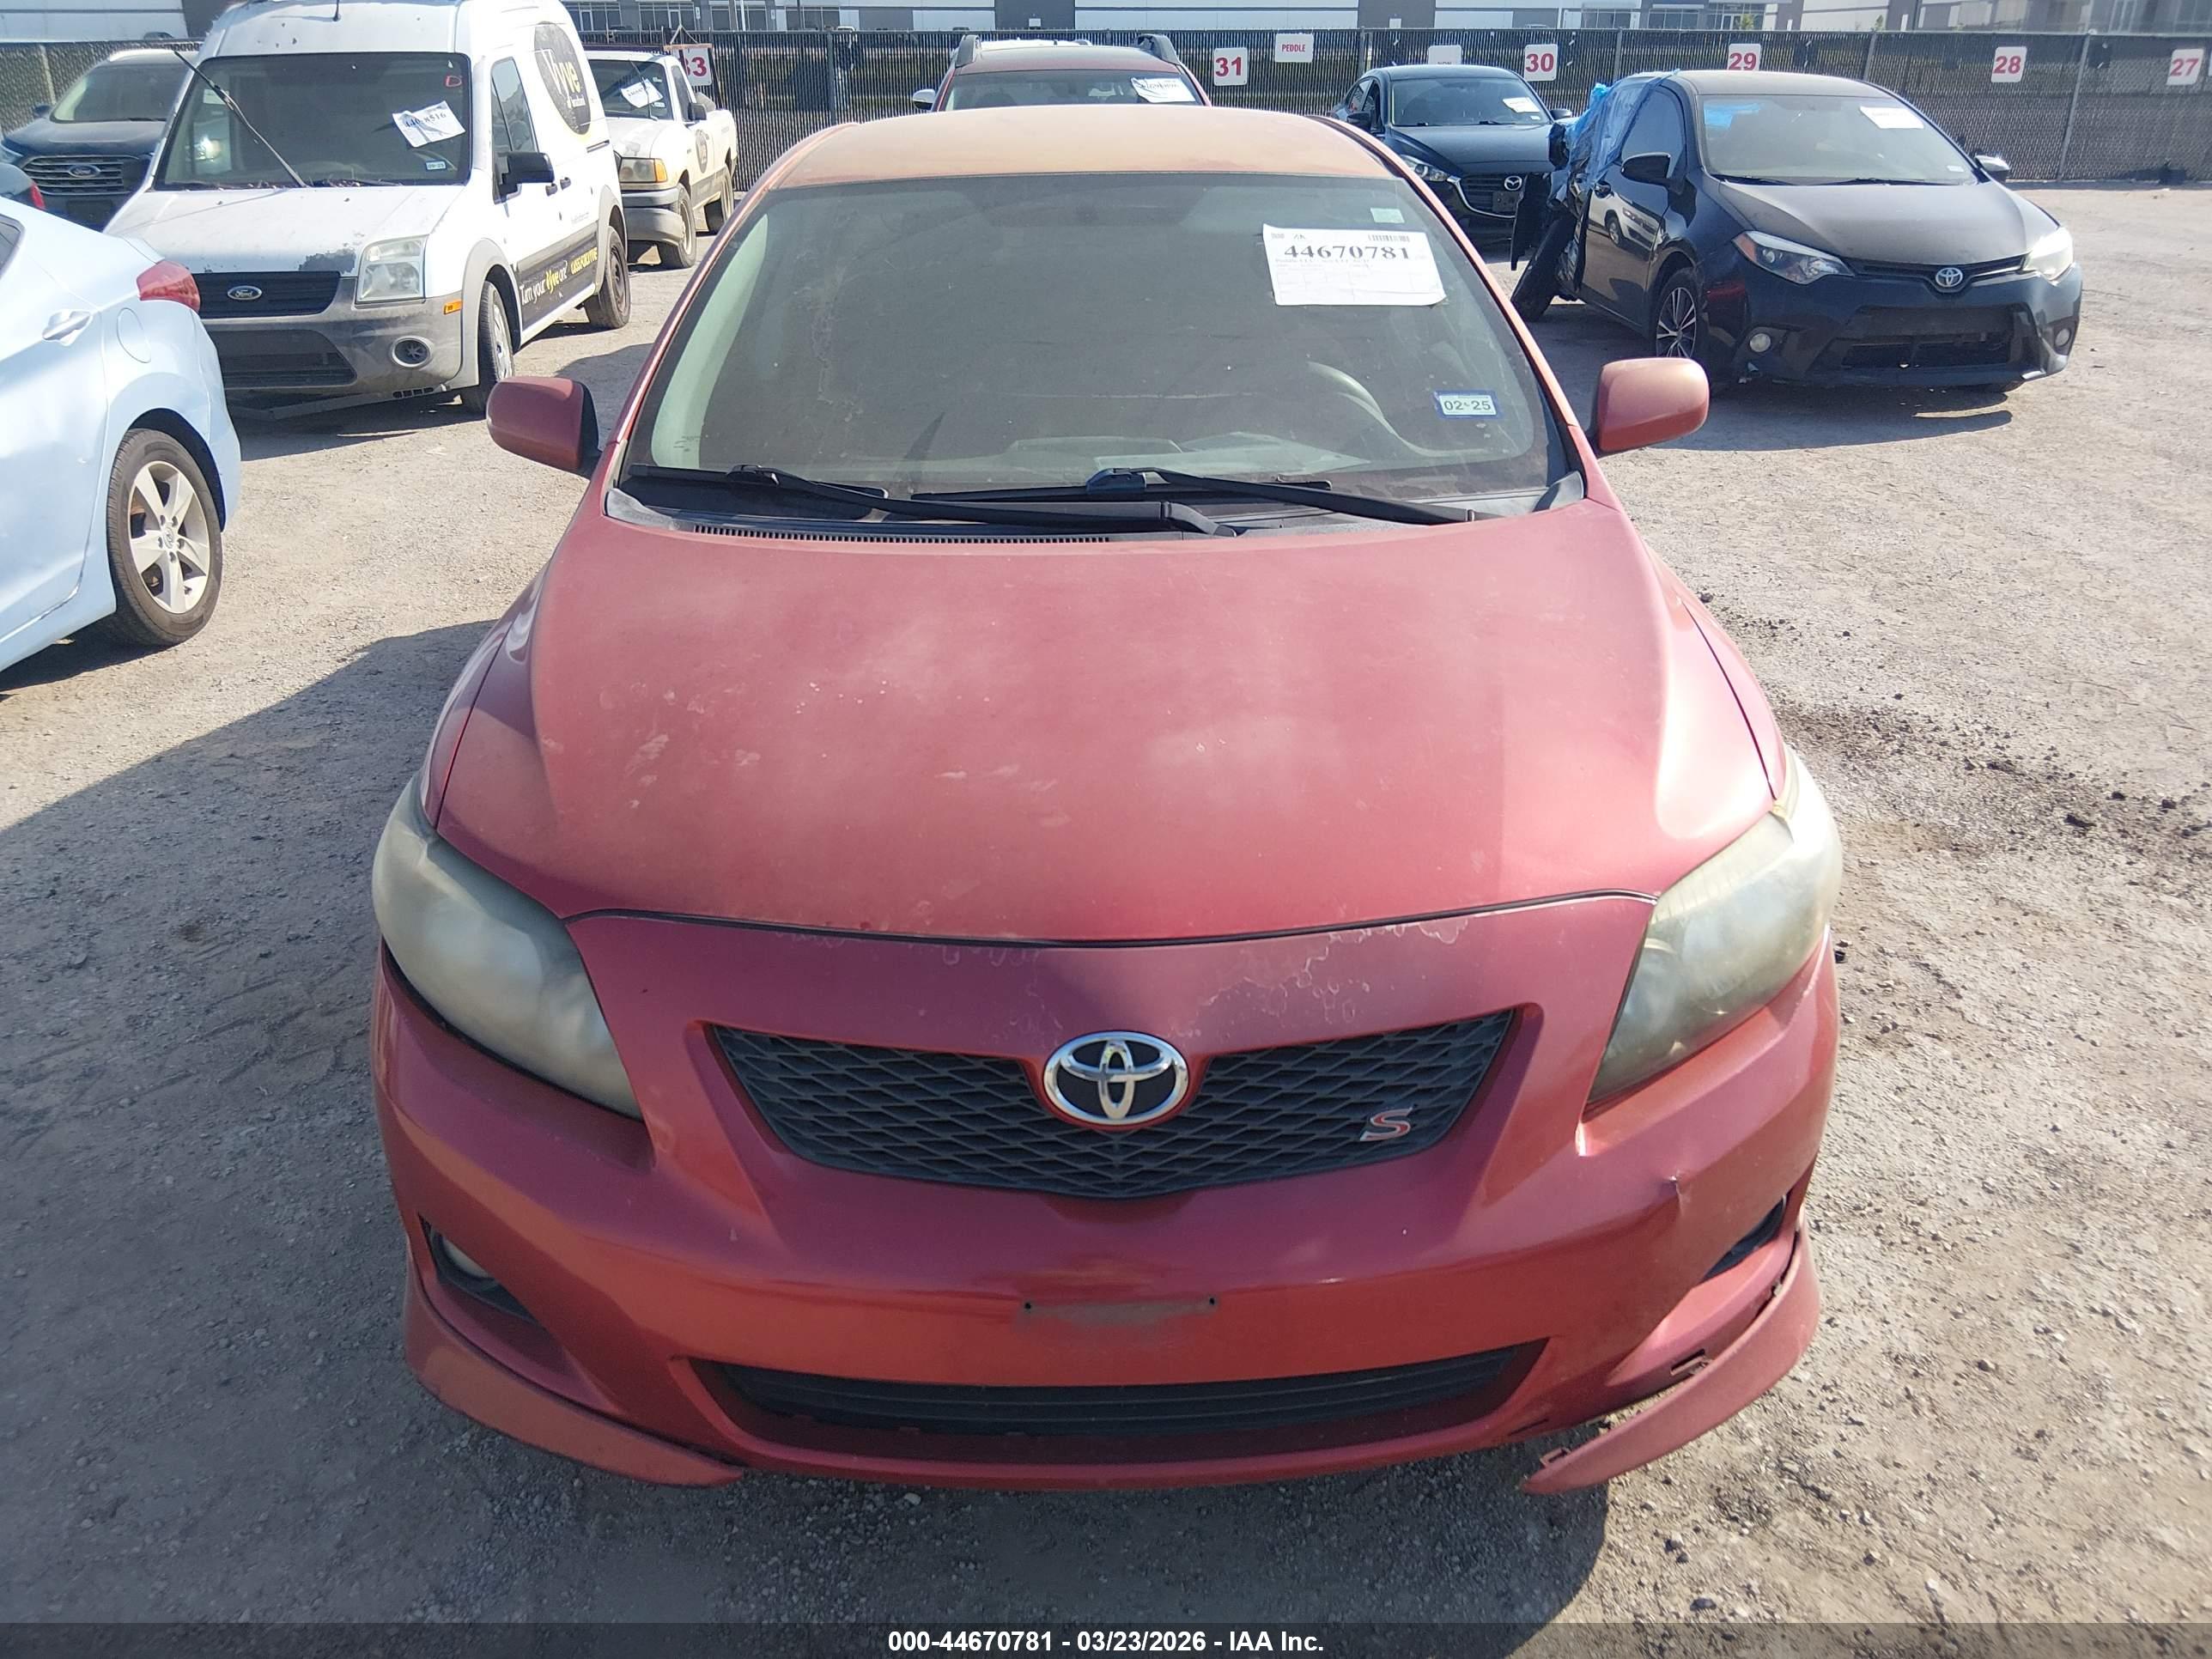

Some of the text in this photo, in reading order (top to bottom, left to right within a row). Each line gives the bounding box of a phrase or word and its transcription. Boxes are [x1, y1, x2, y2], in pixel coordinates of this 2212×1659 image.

[1281, 44, 1306, 52] PEDDLE
[1215, 57, 1242, 77] 31
[1525, 53, 1554, 72] 30
[1729, 52, 1757, 70] 29
[1993, 56, 2021, 74] 28
[2170, 58, 2199, 76] 27
[1284, 244, 1411, 259] 44670781
